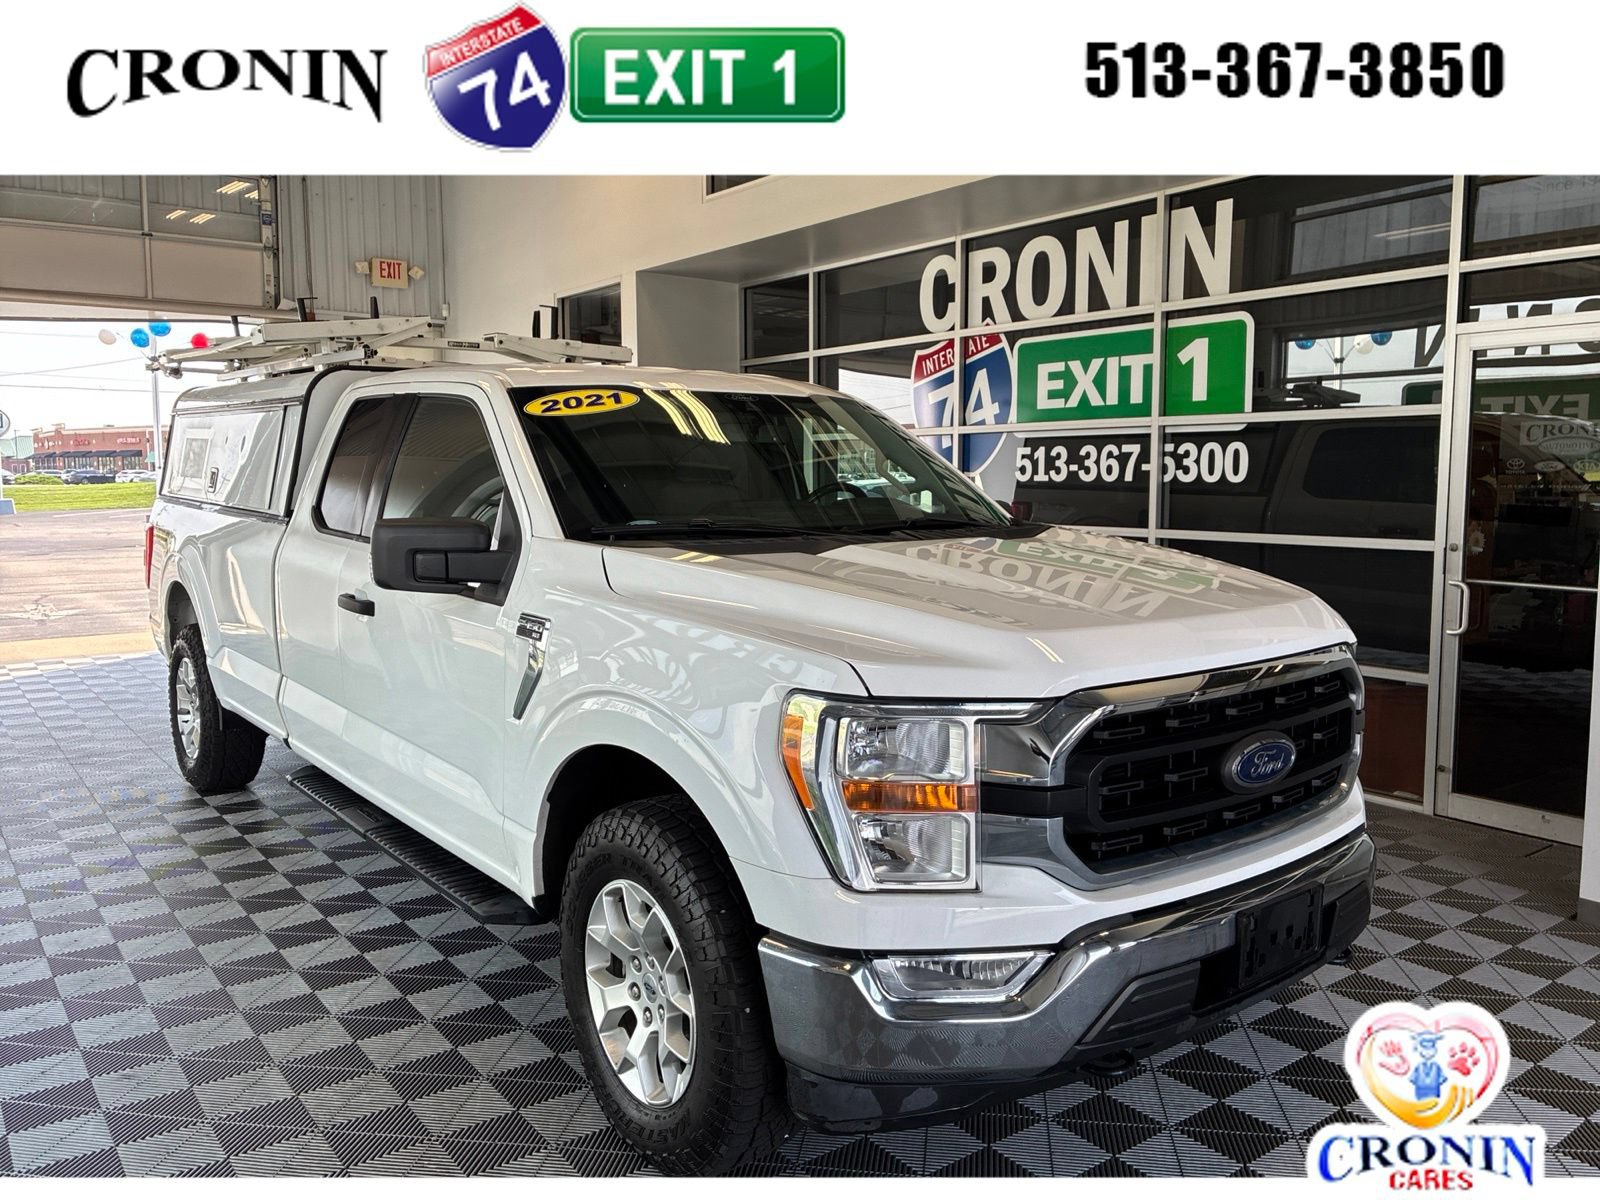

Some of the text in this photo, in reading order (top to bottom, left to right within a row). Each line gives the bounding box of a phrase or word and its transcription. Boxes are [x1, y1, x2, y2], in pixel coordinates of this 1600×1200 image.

[379, 261, 402, 279] EXIT
[919, 198, 1234, 334] CRONIN
[922, 335, 991, 377] INTERATE
[1037, 337, 1209, 410] EXIT 1
[541, 391, 624, 414] 2021
[927, 368, 1000, 449] 74
[1015, 441, 1249, 484] 513-367-5300
[1250, 750, 1284, 777] Ford
